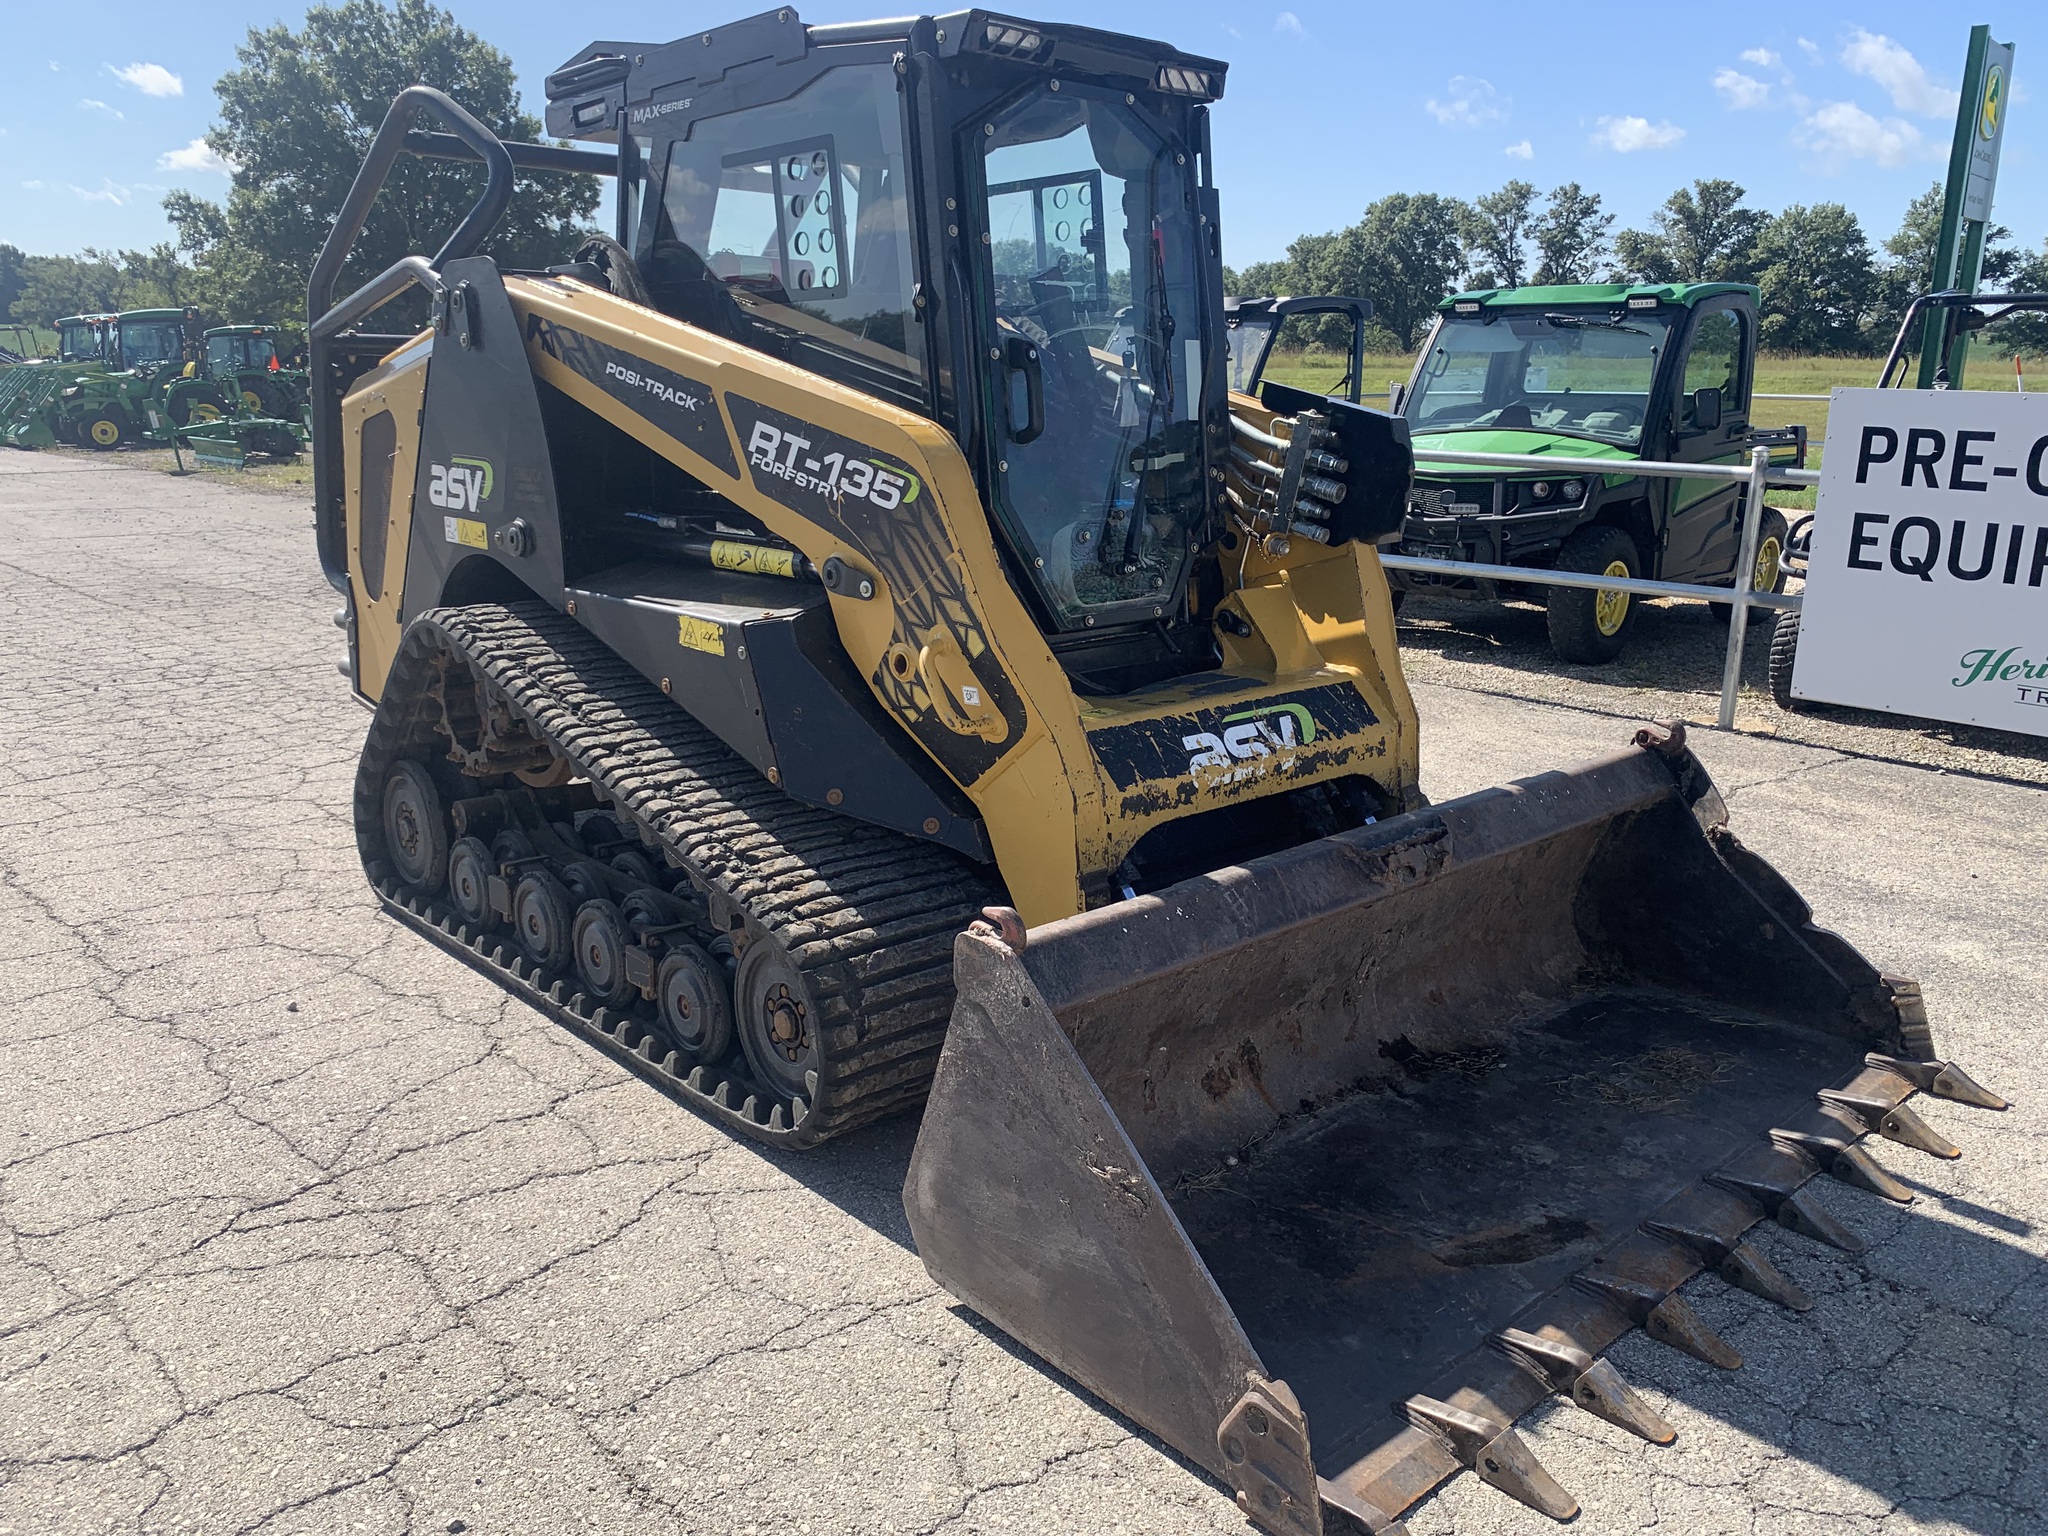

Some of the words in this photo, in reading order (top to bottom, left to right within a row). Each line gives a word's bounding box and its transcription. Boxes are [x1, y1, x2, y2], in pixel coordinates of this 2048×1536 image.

[633, 99, 691, 123] MAX-SERIES
[605, 361, 698, 411] POSI-TRACK
[748, 420, 905, 510] RT-135
[751, 453, 843, 500] FORESTRY
